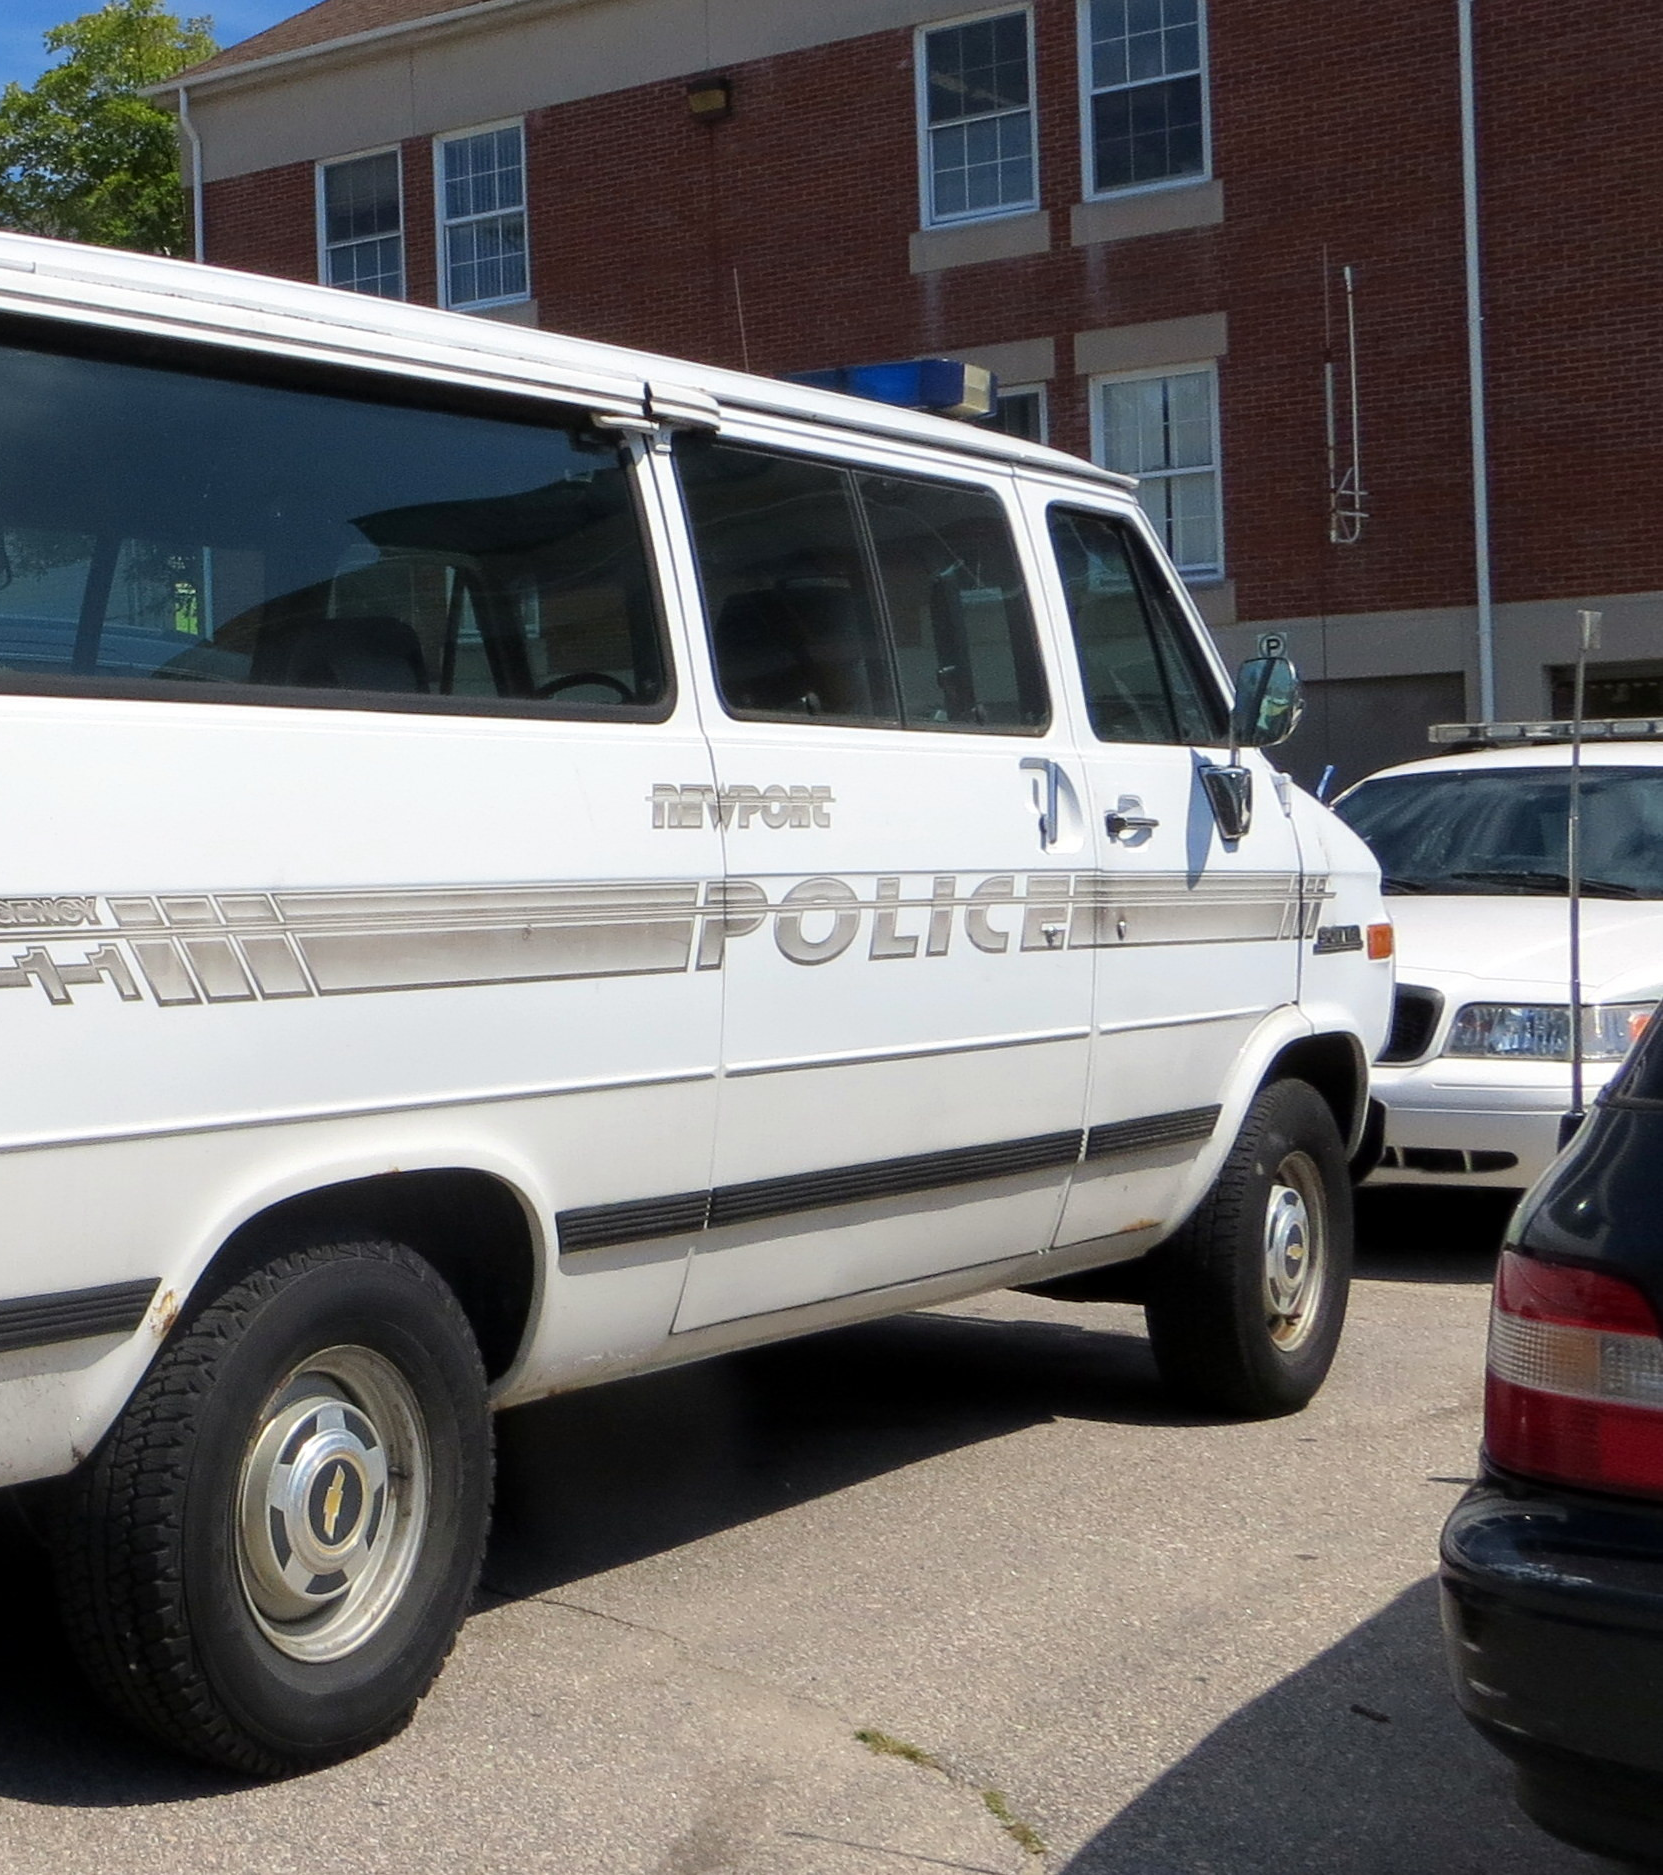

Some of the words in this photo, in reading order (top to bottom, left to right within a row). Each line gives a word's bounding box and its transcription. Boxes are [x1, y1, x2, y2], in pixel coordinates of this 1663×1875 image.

[1266, 638, 1280, 656] P
[650, 783, 833, 832] NEWPORT
[695, 874, 1072, 967] POLICE
